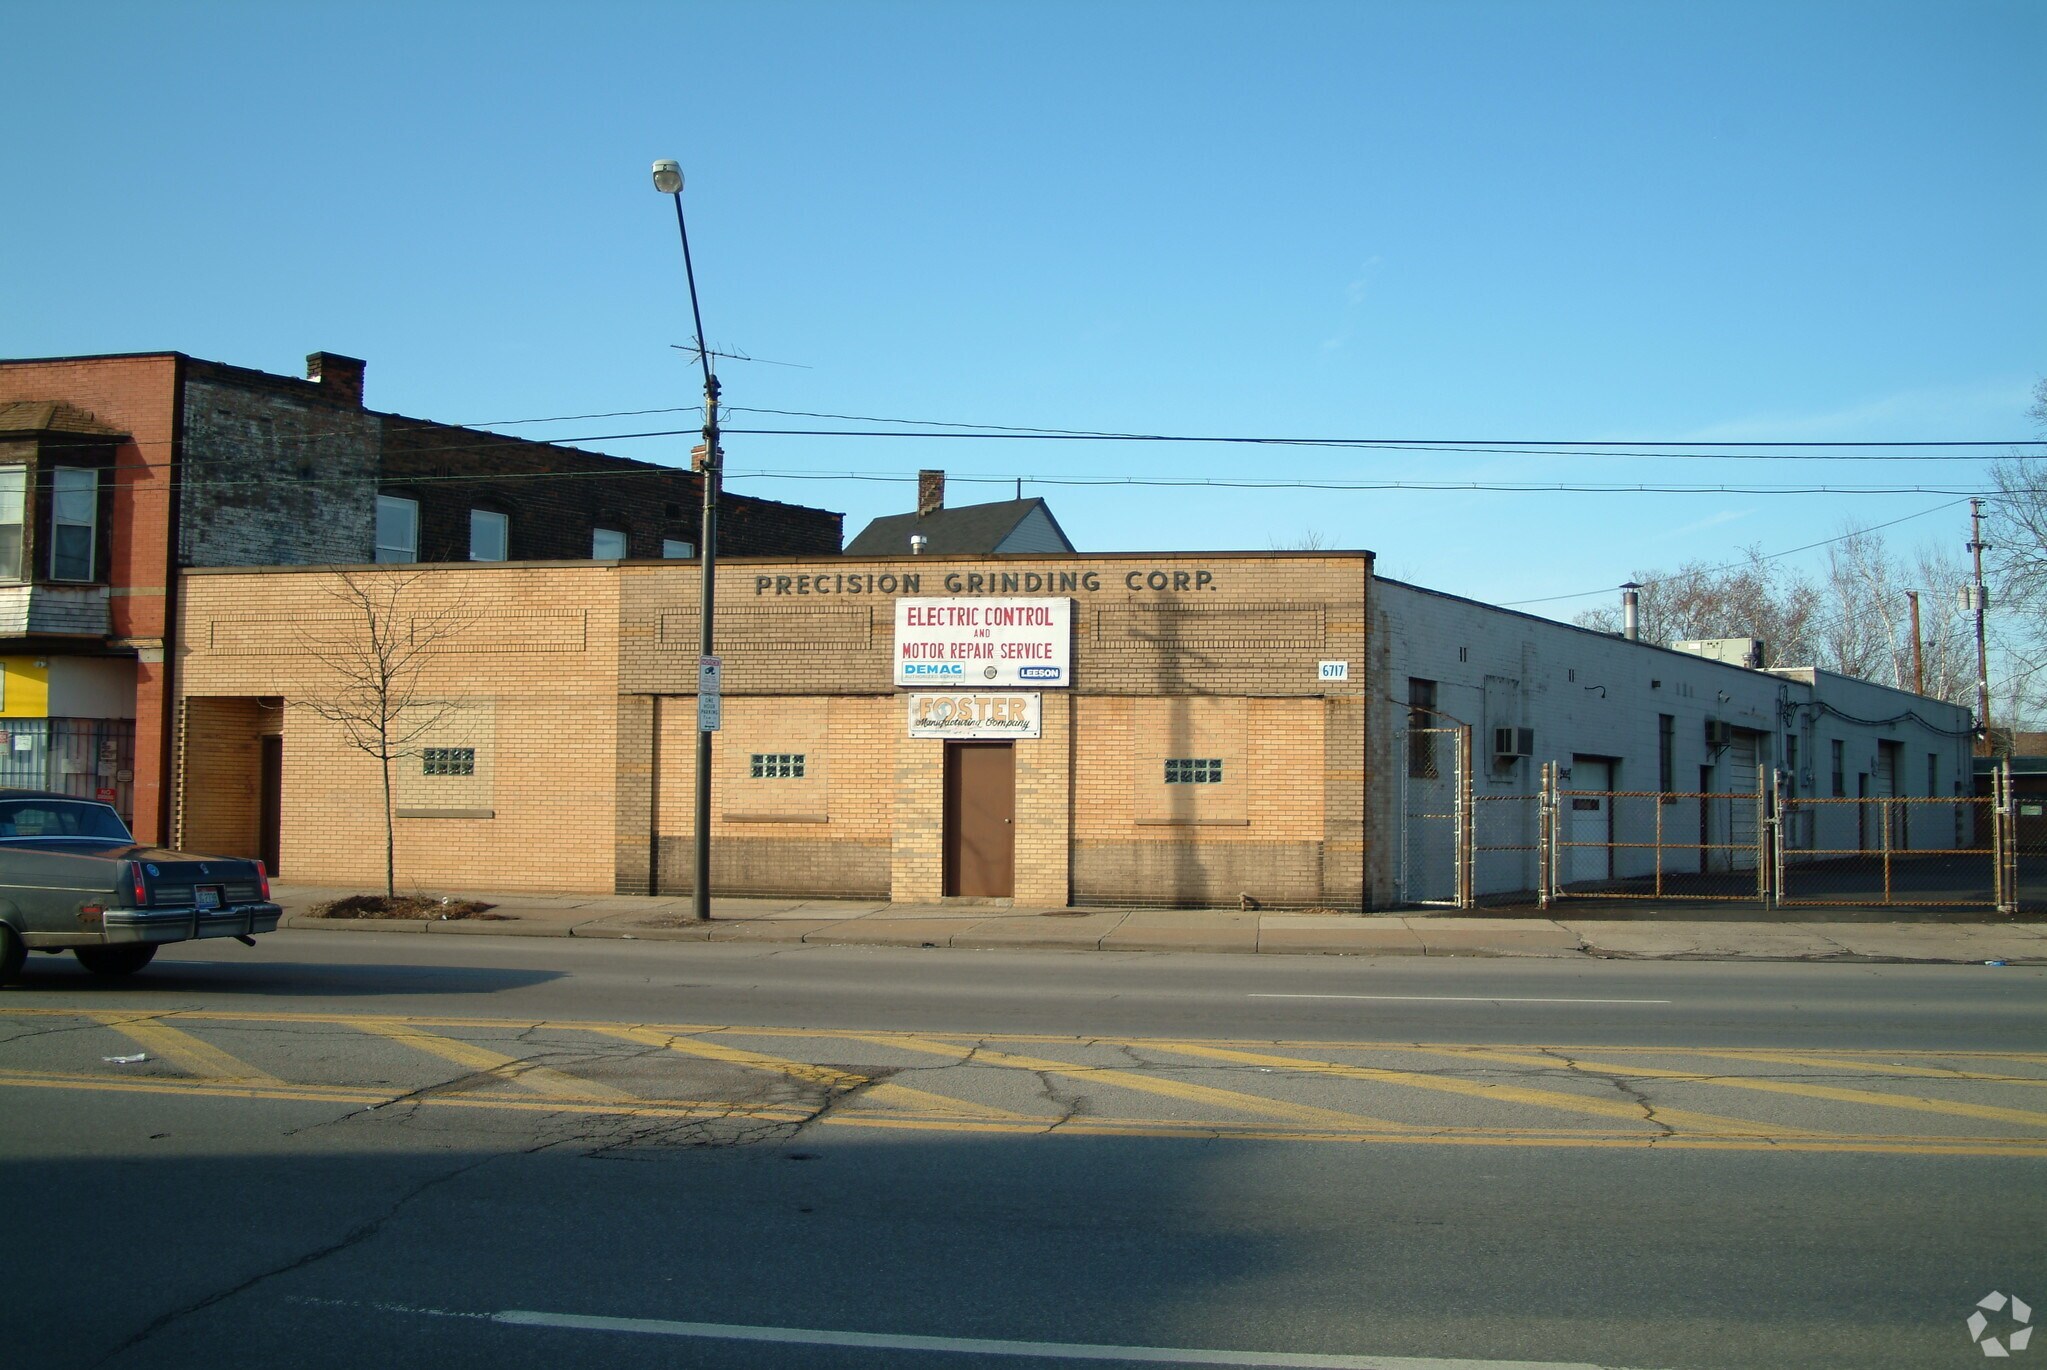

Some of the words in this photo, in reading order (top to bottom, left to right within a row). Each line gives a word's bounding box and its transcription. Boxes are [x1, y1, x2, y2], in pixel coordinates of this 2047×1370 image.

[756, 574, 920, 595] PRECISION
[944, 571, 1100, 593] GRINDING
[1125, 570, 1217, 591] CORP.
[907, 606, 979, 626] ELECTRIC
[985, 606, 1054, 626] CONTROL
[974, 628, 991, 638] AND
[902, 643, 944, 659] MOTOR
[950, 643, 994, 659] REPAIR
[1000, 643, 1052, 659] SERVICE
[905, 664, 962, 674] DEMAG
[1021, 669, 1059, 677] LEESON
[1322, 664, 1345, 677] 6717
[919, 697, 1027, 721] FOSTER
[915, 715, 982, 729] Manufacturing
[985, 716, 1030, 731] Company
